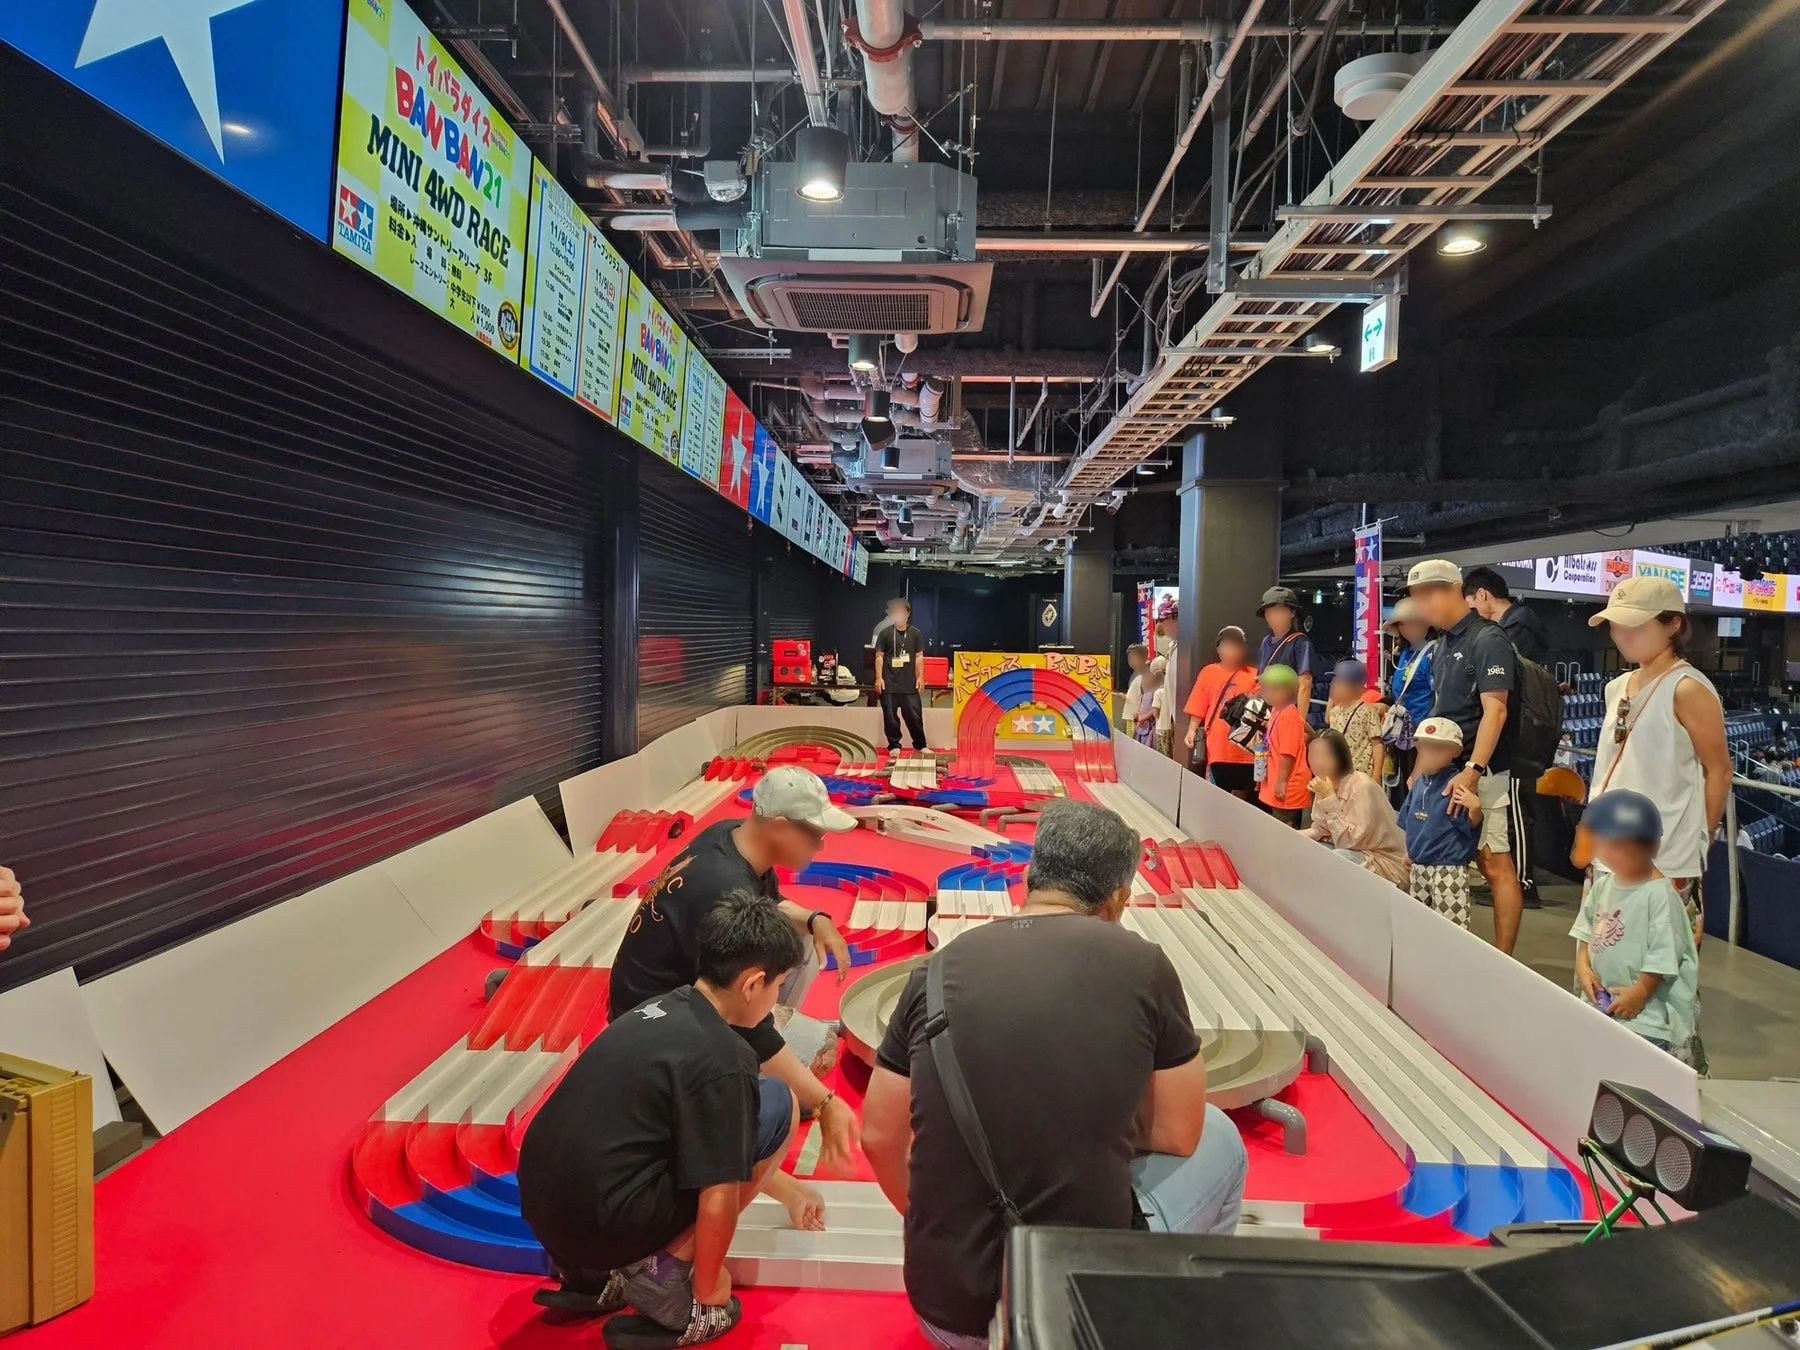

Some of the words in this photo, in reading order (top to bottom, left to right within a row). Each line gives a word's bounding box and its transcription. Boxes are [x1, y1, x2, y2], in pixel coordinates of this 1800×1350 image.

[416, 36, 491, 149] トイパラダイス
[367, 114, 423, 193] MINI
[424, 168, 466, 228] 4WD
[467, 207, 511, 269] RACE
[338, 221, 372, 256] TAMIYA
[550, 220, 576, 260] 11/8(土)
[483, 267, 493, 285] 3F
[630, 353, 648, 385] MINI
[648, 369, 662, 396] 4WD
[661, 378, 677, 411] RACE
[1563, 570, 1596, 584] Corporation
[1690, 570, 1713, 591] 358
[1356, 568, 1370, 664] TAMI
[1487, 667, 1505, 676] 1982
